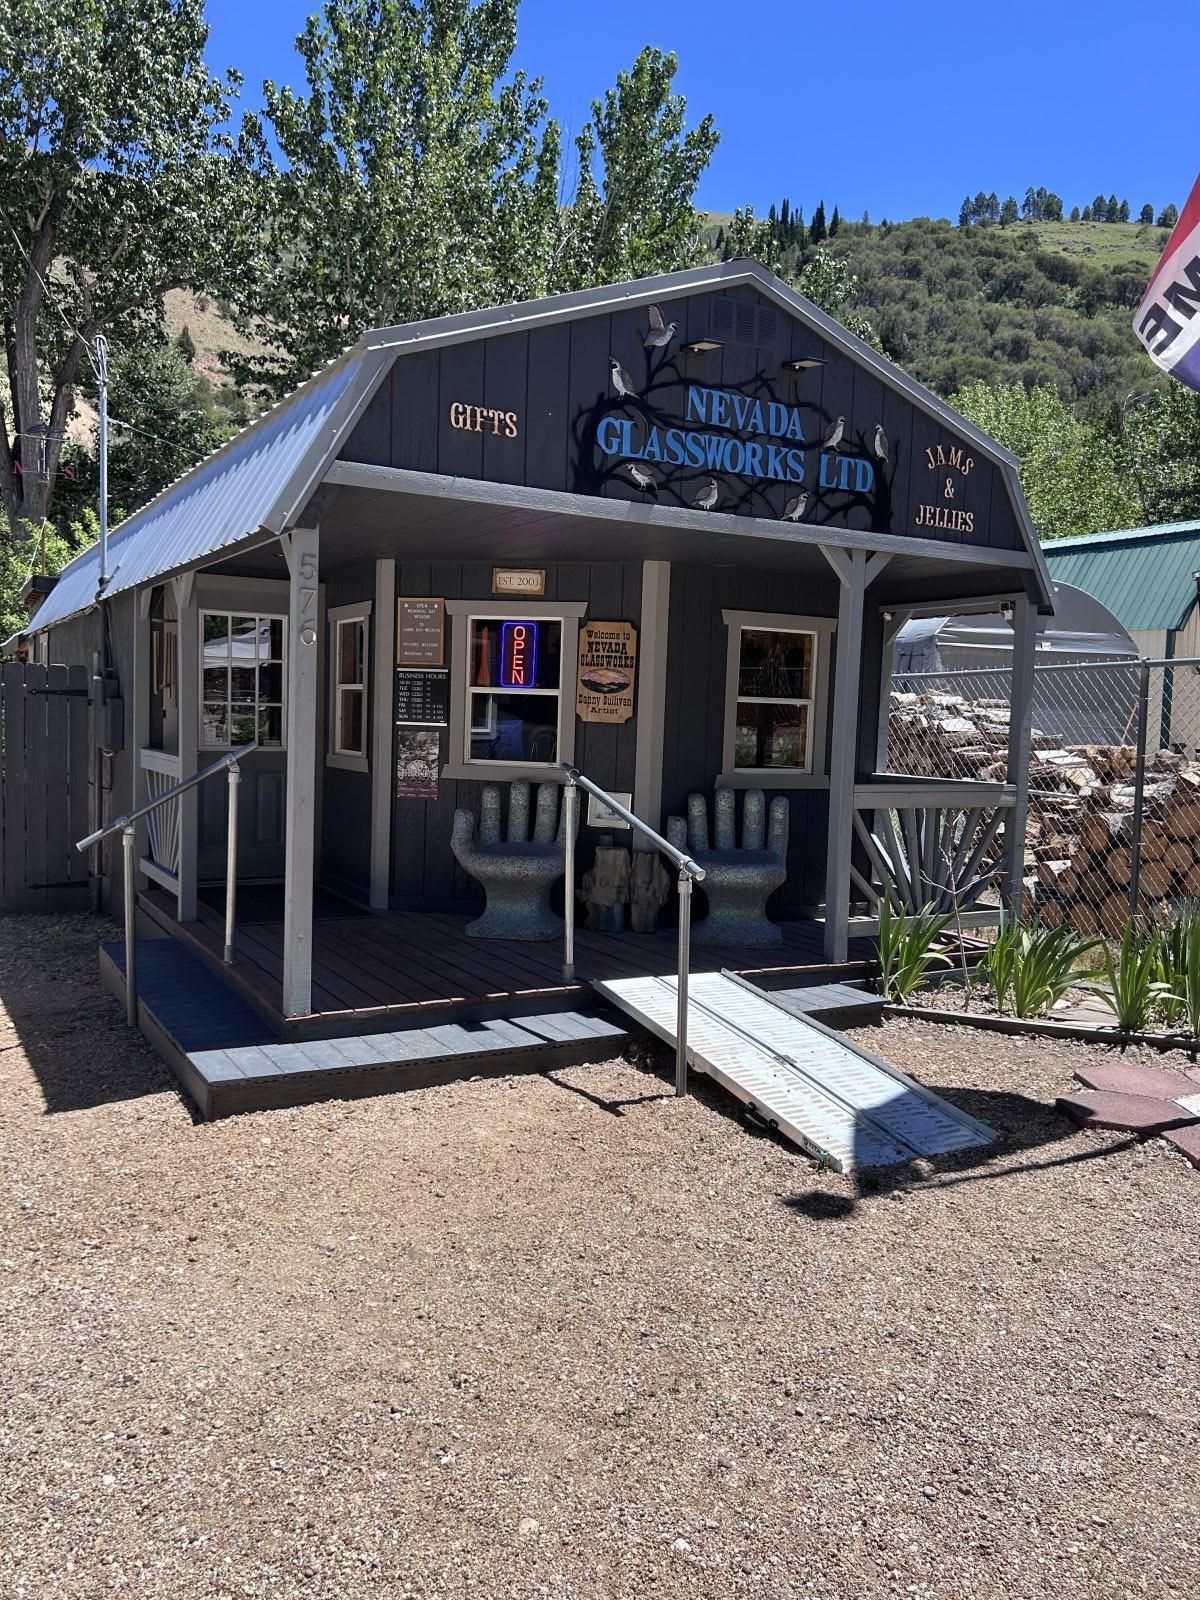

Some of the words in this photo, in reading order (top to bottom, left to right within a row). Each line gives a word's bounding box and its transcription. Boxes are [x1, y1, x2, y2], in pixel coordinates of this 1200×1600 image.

[450, 402, 518, 438] GIFTS
[685, 385, 805, 441] NEVADA
[596, 416, 805, 483] GLASSWORKS
[818, 453, 874, 493] LTD
[925, 444, 974, 475] JAMS
[944, 477, 955, 498] &
[915, 504, 974, 532] JELLIES
[517, 577, 539, 586] 2003
[299, 553, 317, 646] 576
[586, 629, 620, 640] Welcome
[623, 631, 631, 640] to
[511, 625, 526, 685] OPEN
[587, 641, 627, 655] NEVADA
[580, 654, 634, 668] GLASSWORKS
[578, 694, 601, 706] Danny
[603, 694, 632, 707] Sullivan
[590, 706, 618, 715] Artist
